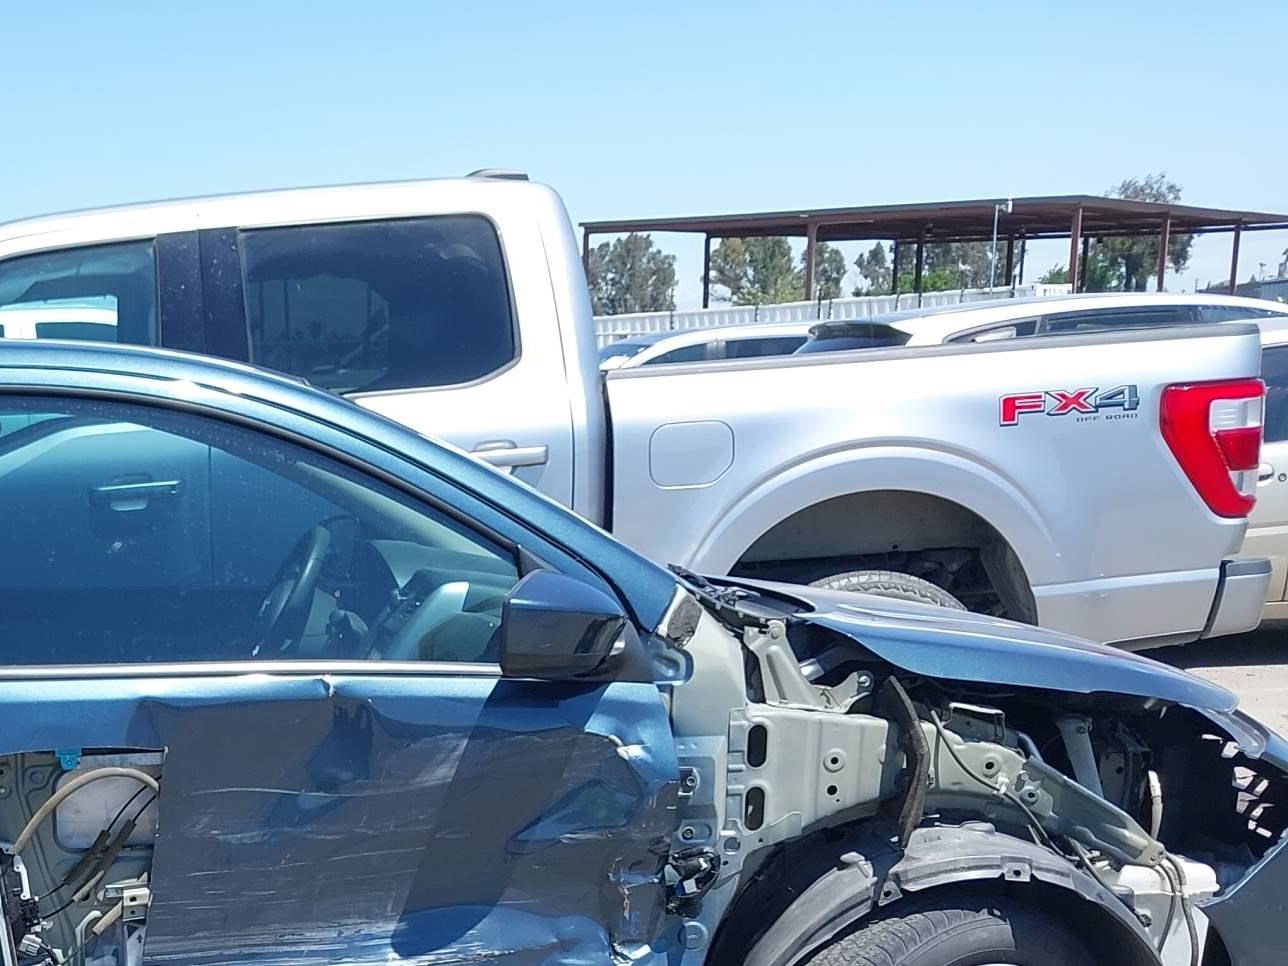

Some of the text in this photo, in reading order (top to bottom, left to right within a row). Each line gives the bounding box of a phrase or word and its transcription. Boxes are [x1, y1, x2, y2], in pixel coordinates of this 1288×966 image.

[998, 384, 1140, 427] FX4
[1076, 413, 1139, 424] OFF ROAD
